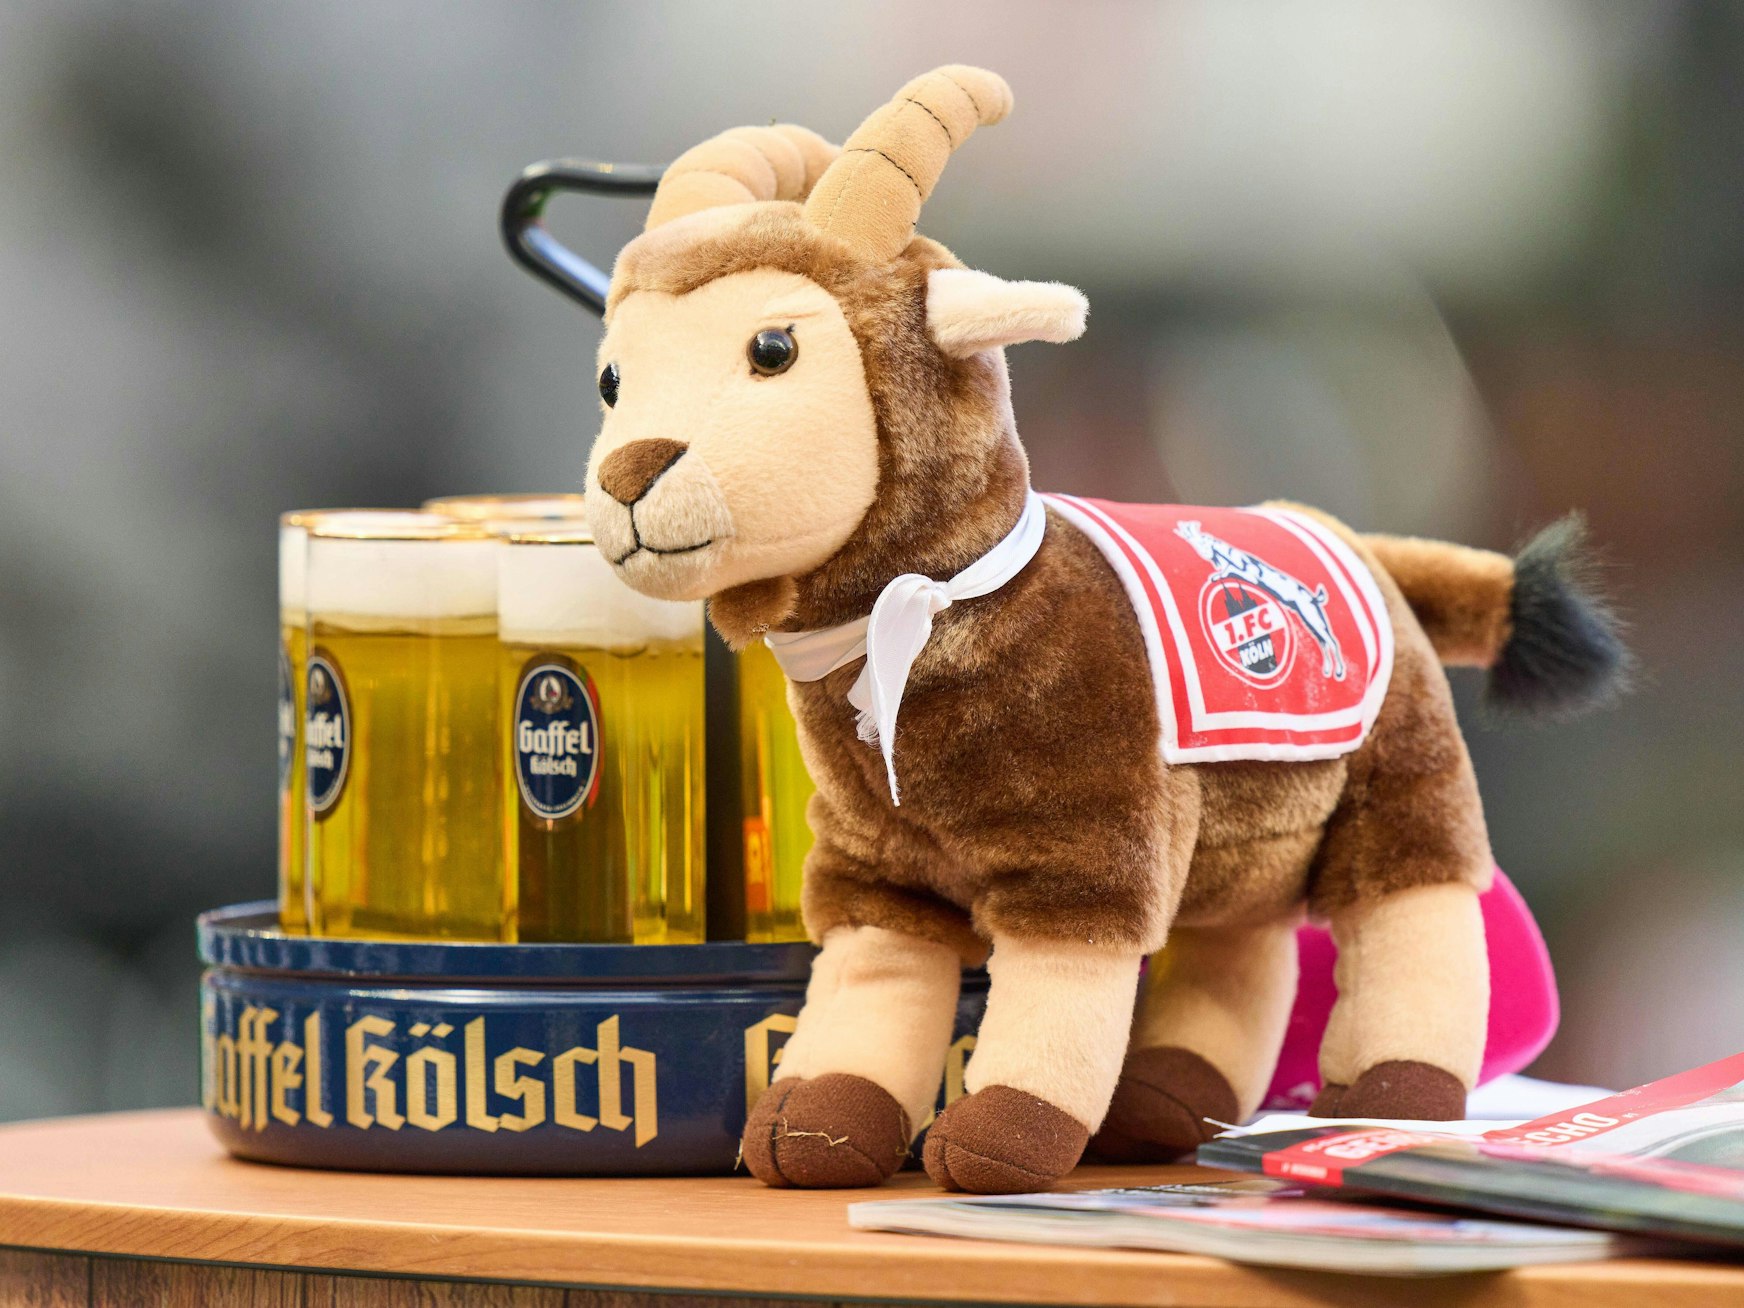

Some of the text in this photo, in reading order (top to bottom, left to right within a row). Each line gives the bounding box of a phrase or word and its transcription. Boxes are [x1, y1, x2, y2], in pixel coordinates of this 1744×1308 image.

[1224, 608, 1272, 645] 1.FC
[1240, 638, 1274, 667] KÖLN
[518, 719, 592, 758] Gaffel
[346, 1013, 659, 1149] Kölsch
